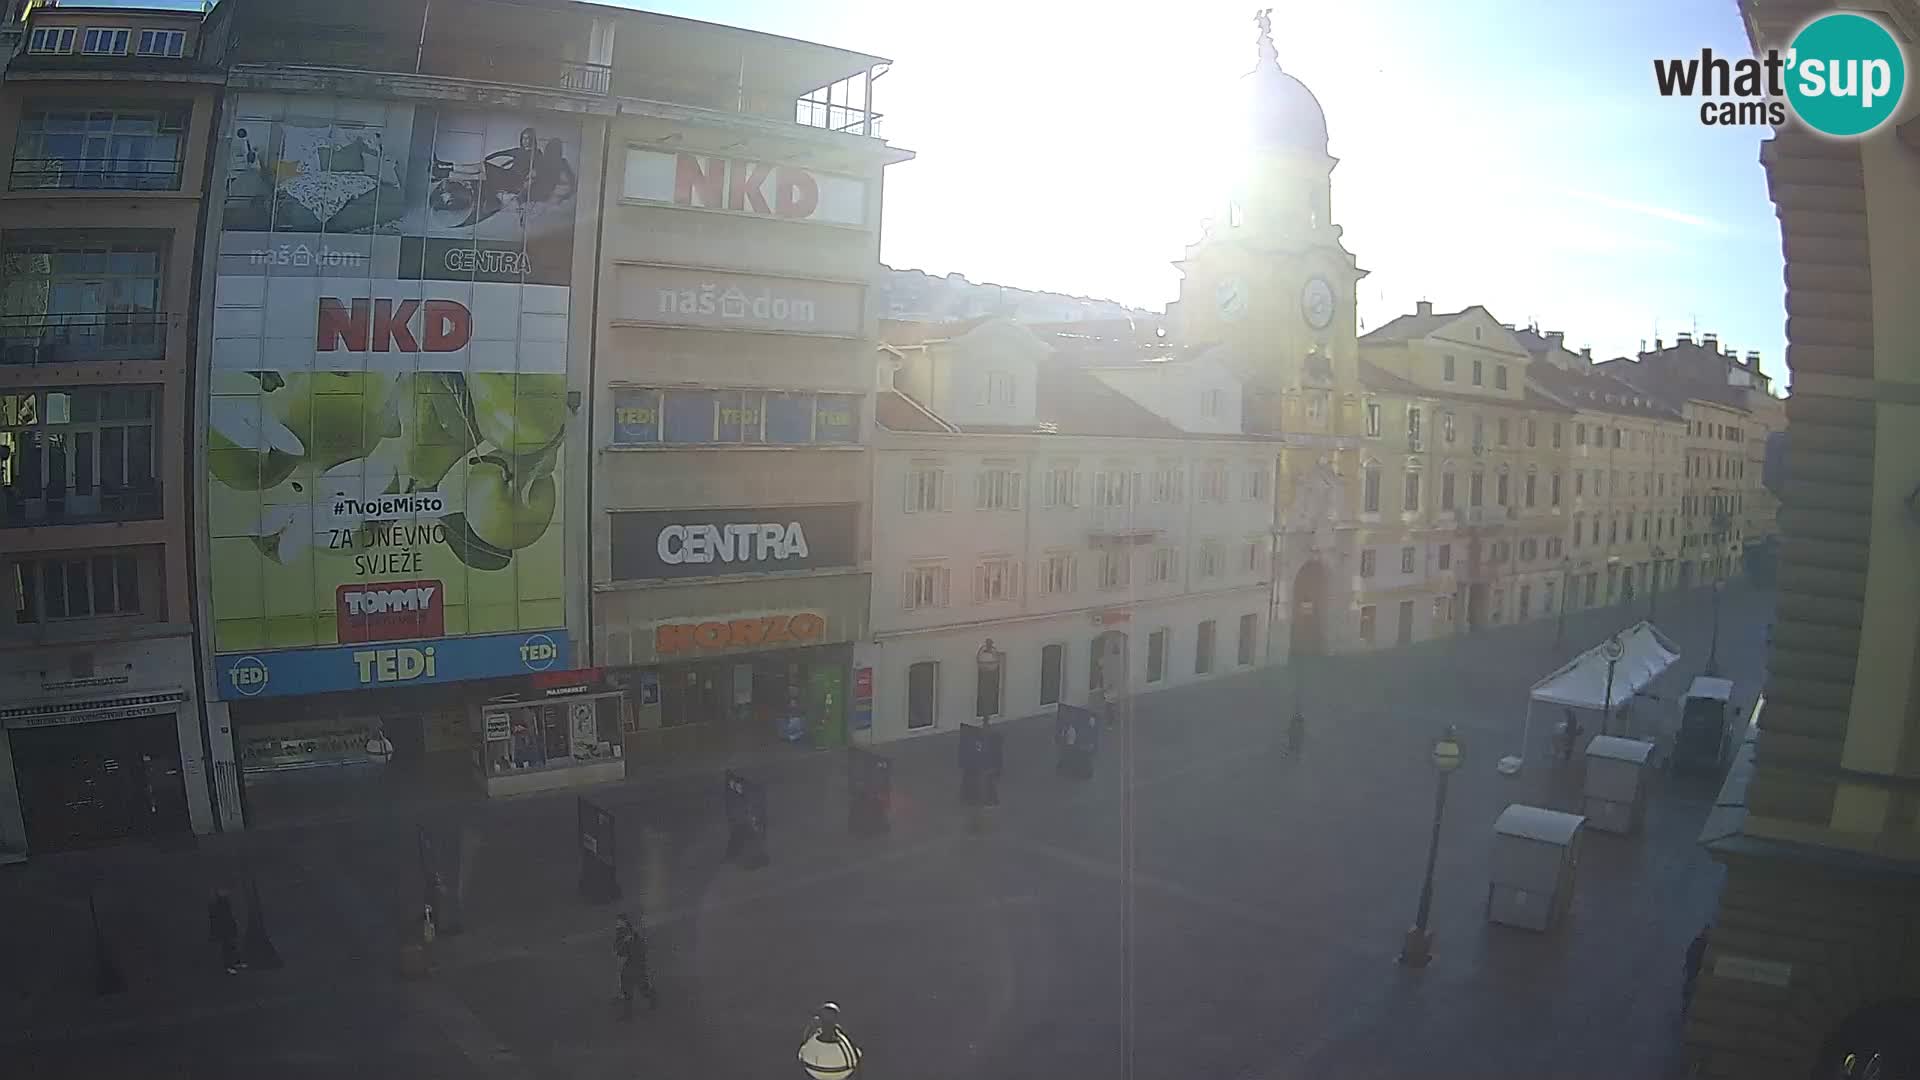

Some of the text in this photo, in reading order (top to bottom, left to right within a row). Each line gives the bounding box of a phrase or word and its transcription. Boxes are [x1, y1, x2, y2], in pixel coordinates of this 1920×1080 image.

[674, 152, 819, 219] NKD
[250, 245, 361, 267] naš dom
[443, 248, 532, 275] CENTRA
[656, 279, 816, 321] naš dom
[316, 296, 474, 354] NKD
[333, 496, 443, 517] #TvojeMisto
[328, 523, 447, 550] ZA DNEVNO
[657, 521, 809, 565] CENTRA
[354, 547, 424, 576] SVJEŽE
[343, 586, 436, 615] TOMMY
[353, 646, 437, 684] TEDi
[519, 643, 558, 662] TEDi
[228, 666, 270, 686] TEDi
